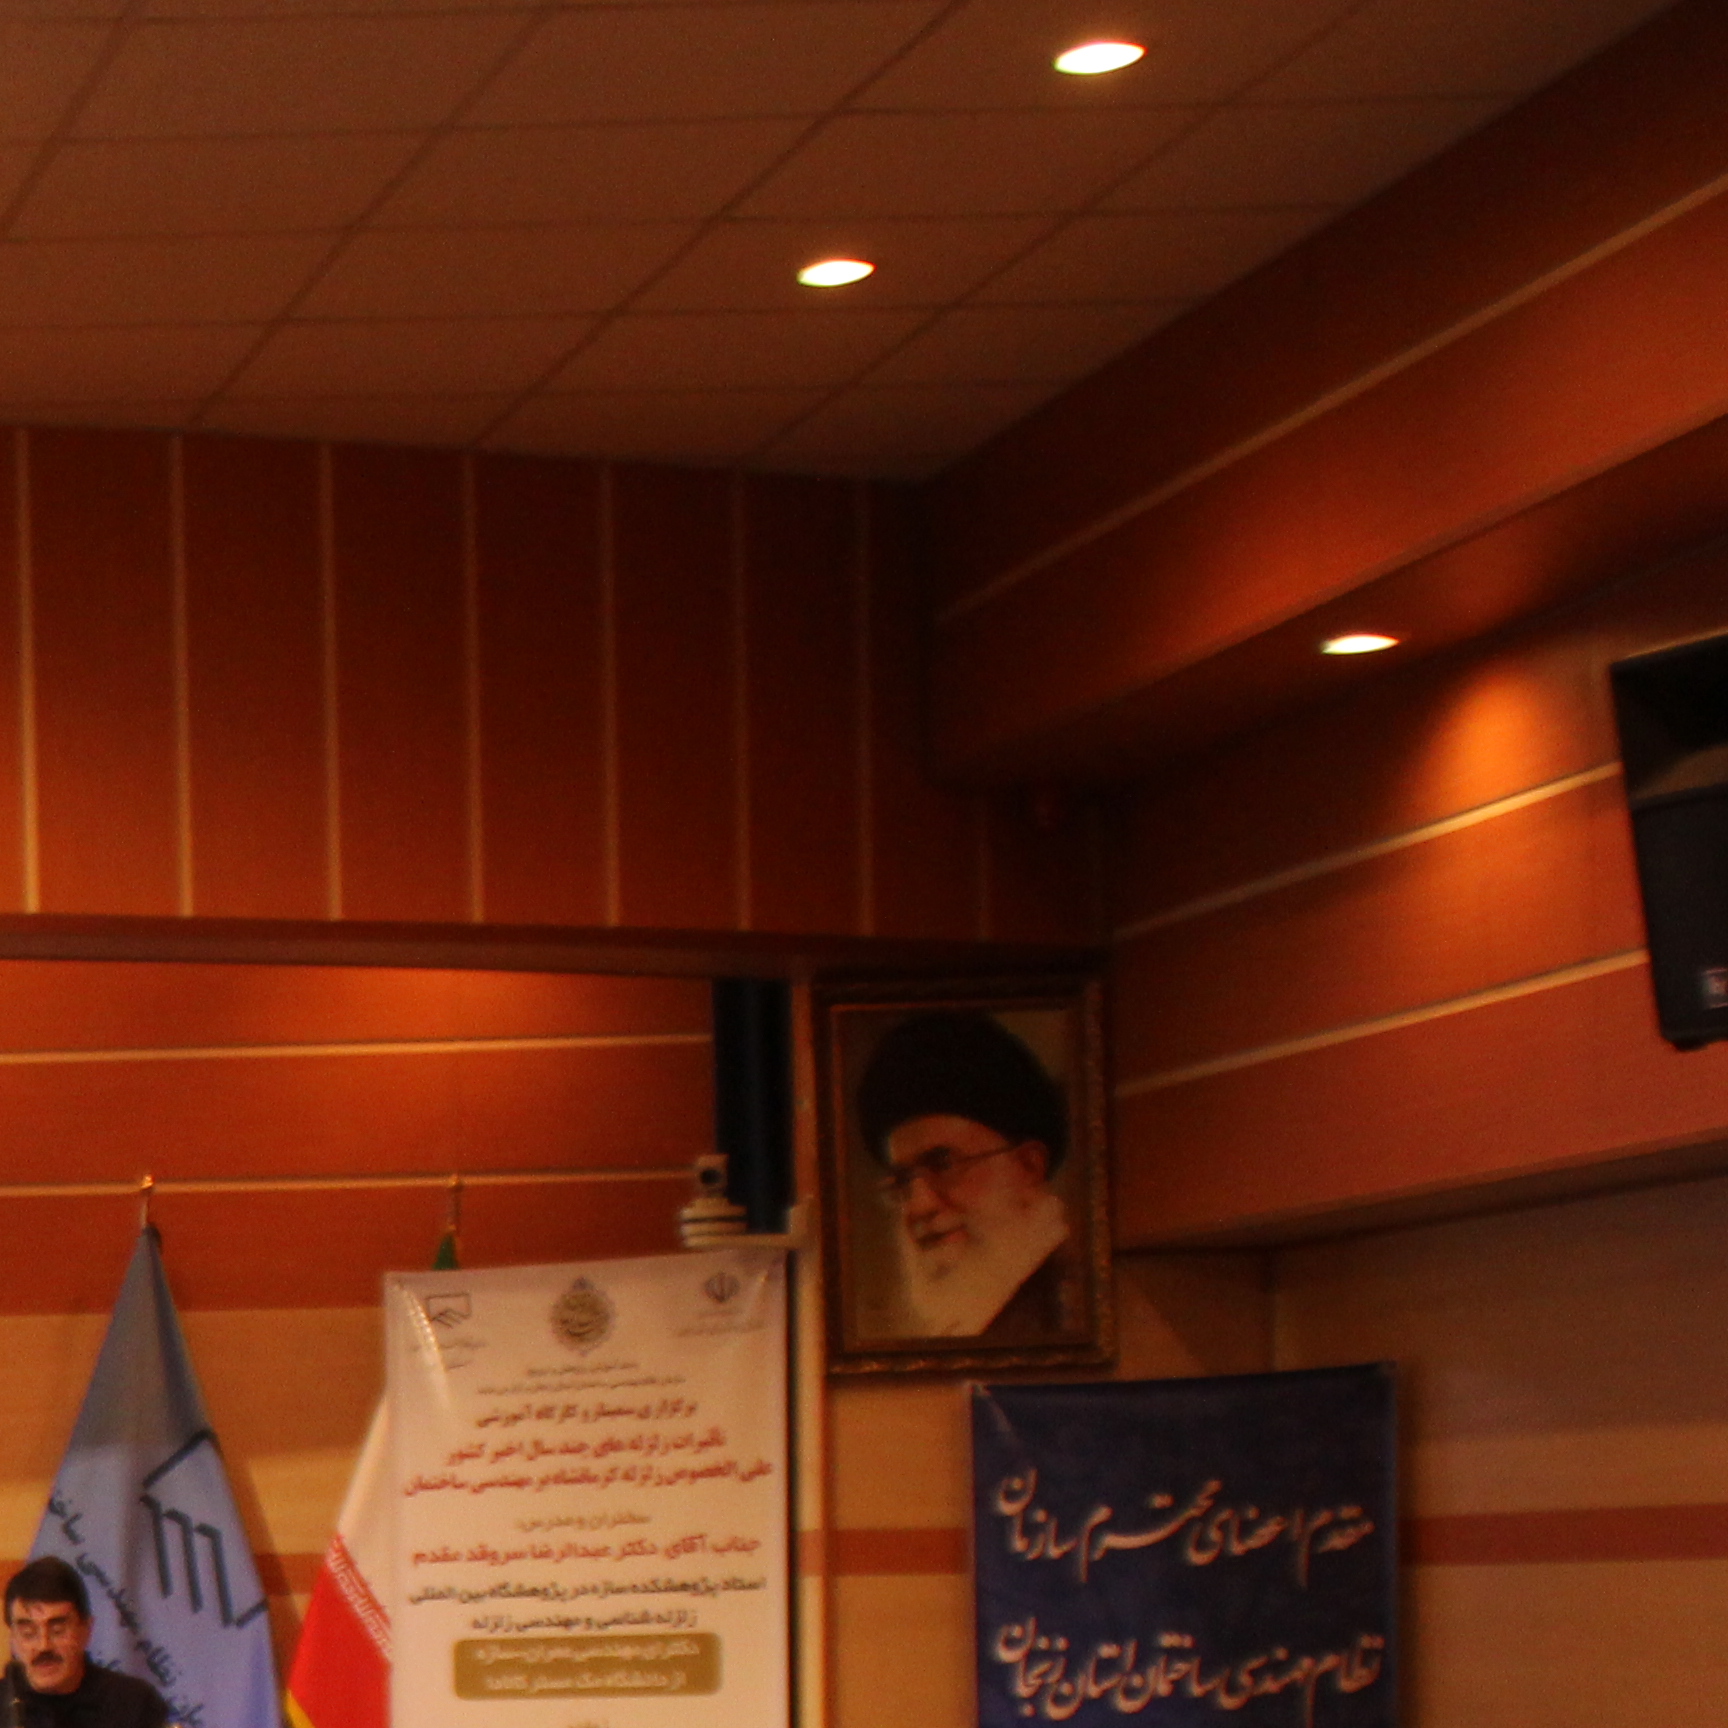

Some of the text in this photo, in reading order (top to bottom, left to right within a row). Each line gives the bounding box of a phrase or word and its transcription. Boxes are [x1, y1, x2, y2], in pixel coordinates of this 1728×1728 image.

[997, 1467, 1376, 1589] مقدم اعضای محترم سازمان
[996, 1616, 1070, 1719] زنجان
[1114, 1631, 1225, 1714] ساختمان
[1218, 1645, 1316, 1711] مهندسی
